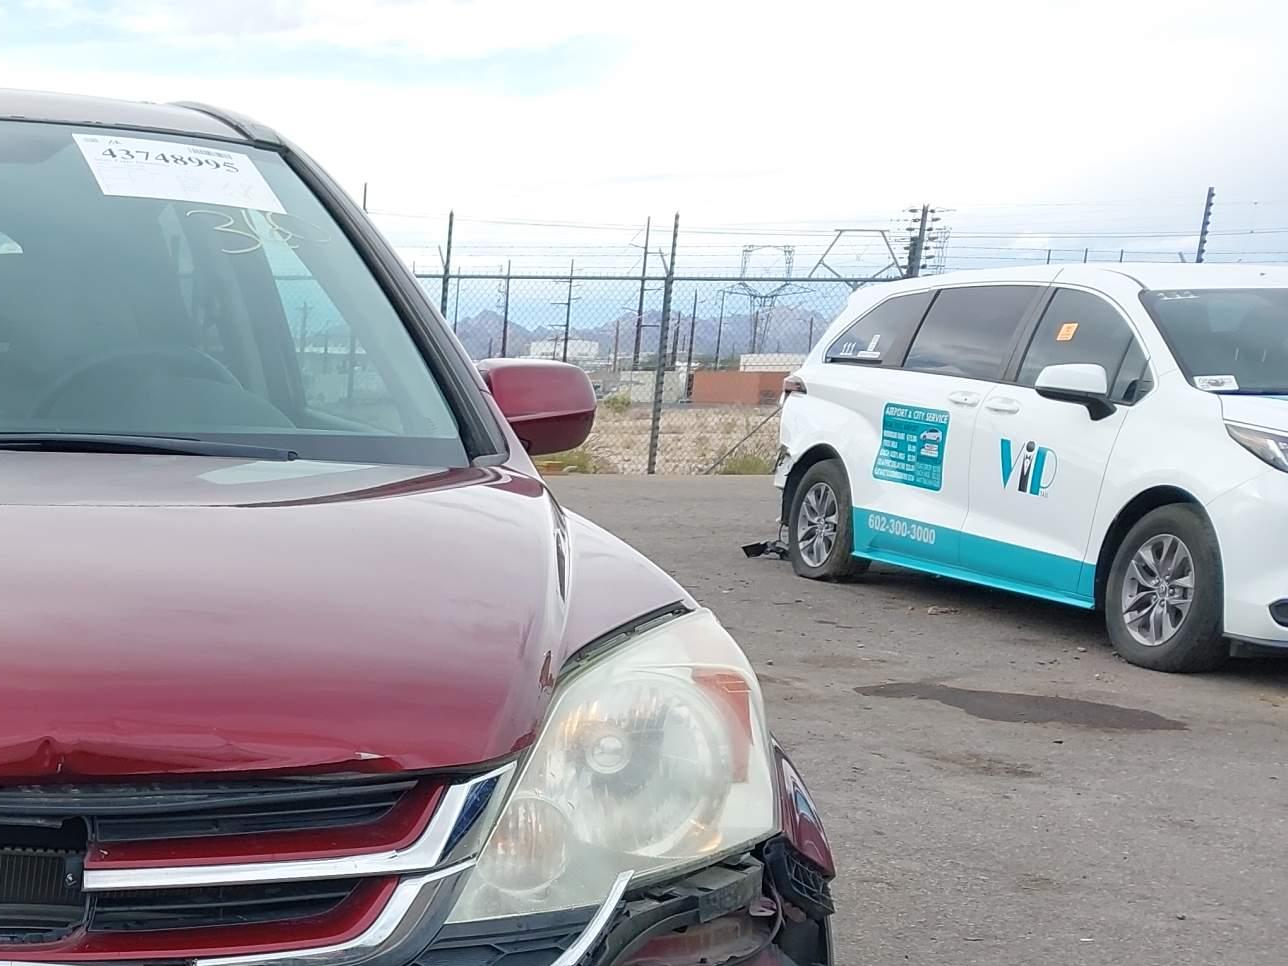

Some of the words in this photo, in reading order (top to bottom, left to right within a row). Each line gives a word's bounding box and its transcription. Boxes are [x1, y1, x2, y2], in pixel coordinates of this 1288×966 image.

[101, 147, 240, 174] 43748995
[885, 406, 909, 418] AIRPORT
[913, 410, 926, 421] CITY
[926, 412, 949, 425] SERVICE
[868, 513, 936, 545] 602-300-3000
